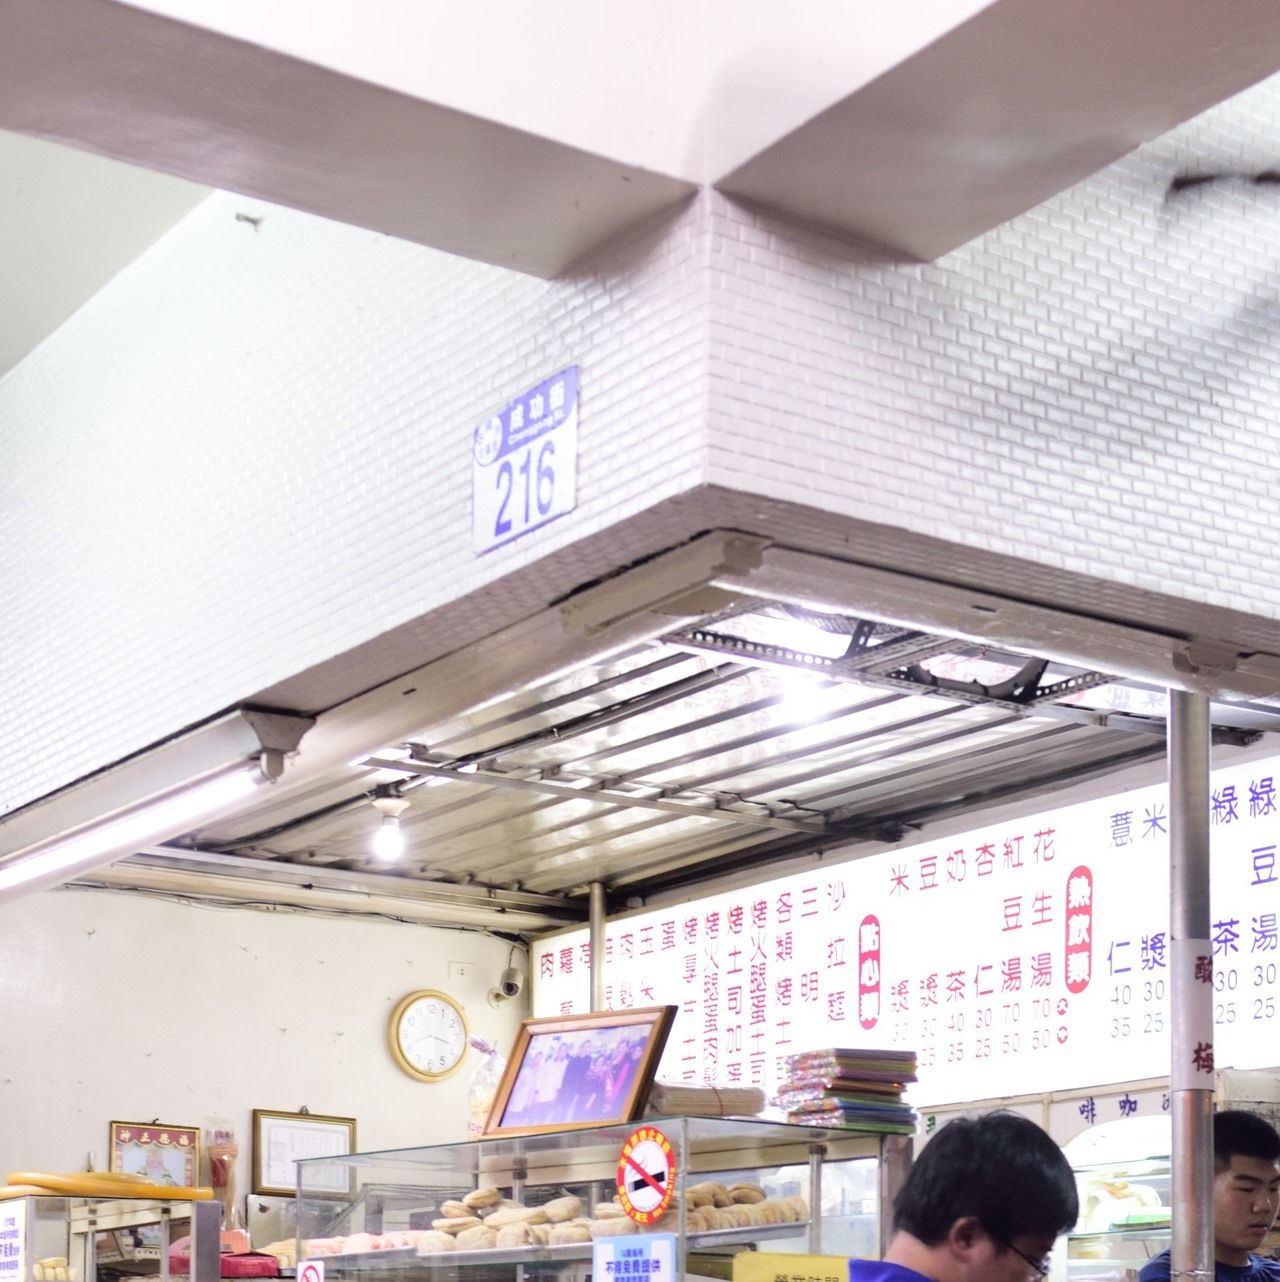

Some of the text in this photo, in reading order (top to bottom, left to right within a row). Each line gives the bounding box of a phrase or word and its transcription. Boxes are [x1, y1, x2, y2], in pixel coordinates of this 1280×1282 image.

[495, 440, 556, 537] 216
[946, 849, 967, 1002] 奶茶
[974, 843, 996, 997] 杏仁
[1001, 835, 1025, 993] 紅豆湯
[1031, 827, 1056, 989] 花生湯
[1107, 810, 1134, 976] 薏仁
[1141, 803, 1168, 971] 米漿
[1211, 785, 1240, 956] 綠茶
[1248, 776, 1279, 954] 綠豆湯
[1110, 984, 1132, 1006] 40
[1143, 979, 1165, 1002] 30
[1215, 969, 1238, 992] 30
[1253, 963, 1277, 987] 30
[1110, 1016, 1132, 1038] 35
[1143, 1012, 1164, 1034] 25
[1215, 1002, 1237, 1025] 25
[1253, 996, 1276, 1020] 25
